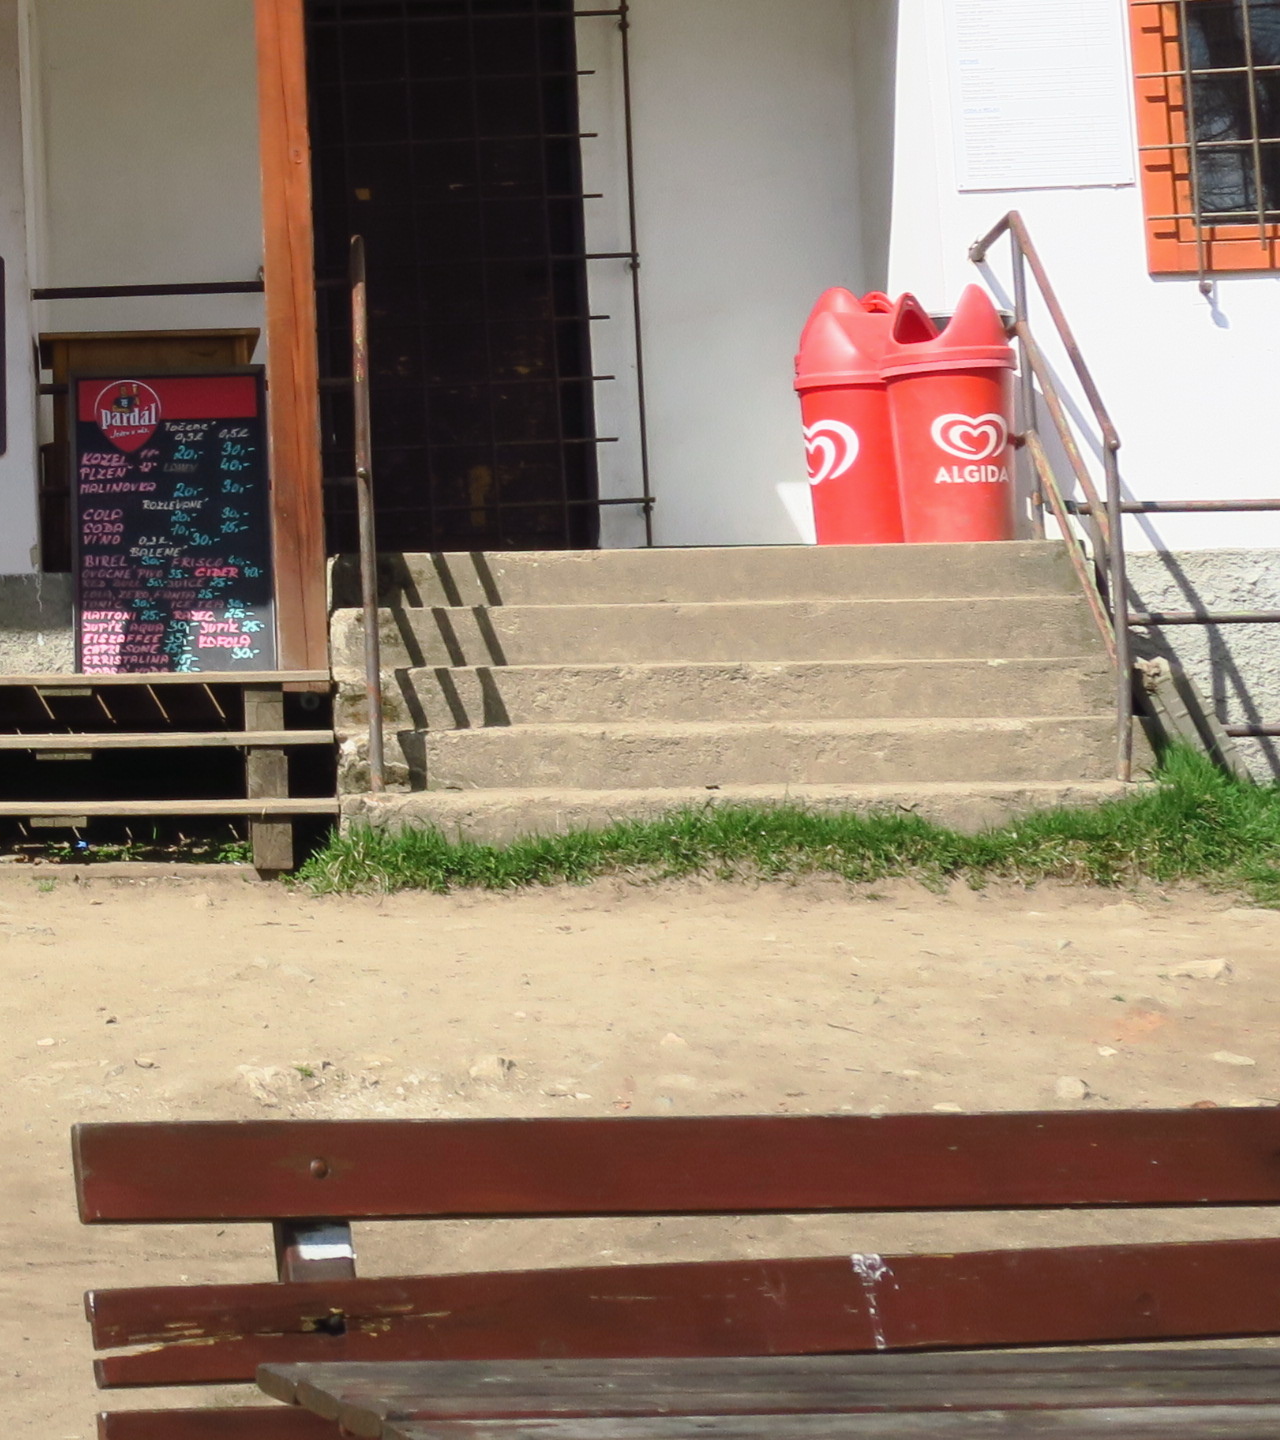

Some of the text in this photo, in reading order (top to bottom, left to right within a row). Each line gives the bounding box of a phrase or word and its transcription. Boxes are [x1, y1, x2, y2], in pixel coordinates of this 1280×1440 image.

[100, 403, 157, 429] pardál
[82, 451, 128, 466] KOZEL
[934, 465, 1010, 484] ALGIDA
[80, 483, 157, 495] MALINOVKA
[82, 509, 123, 520] COLA
[82, 523, 124, 533] SODA
[194, 567, 238, 578] CIDER
[82, 611, 137, 620] MATTONI
[198, 634, 251, 648] KOFOLA
